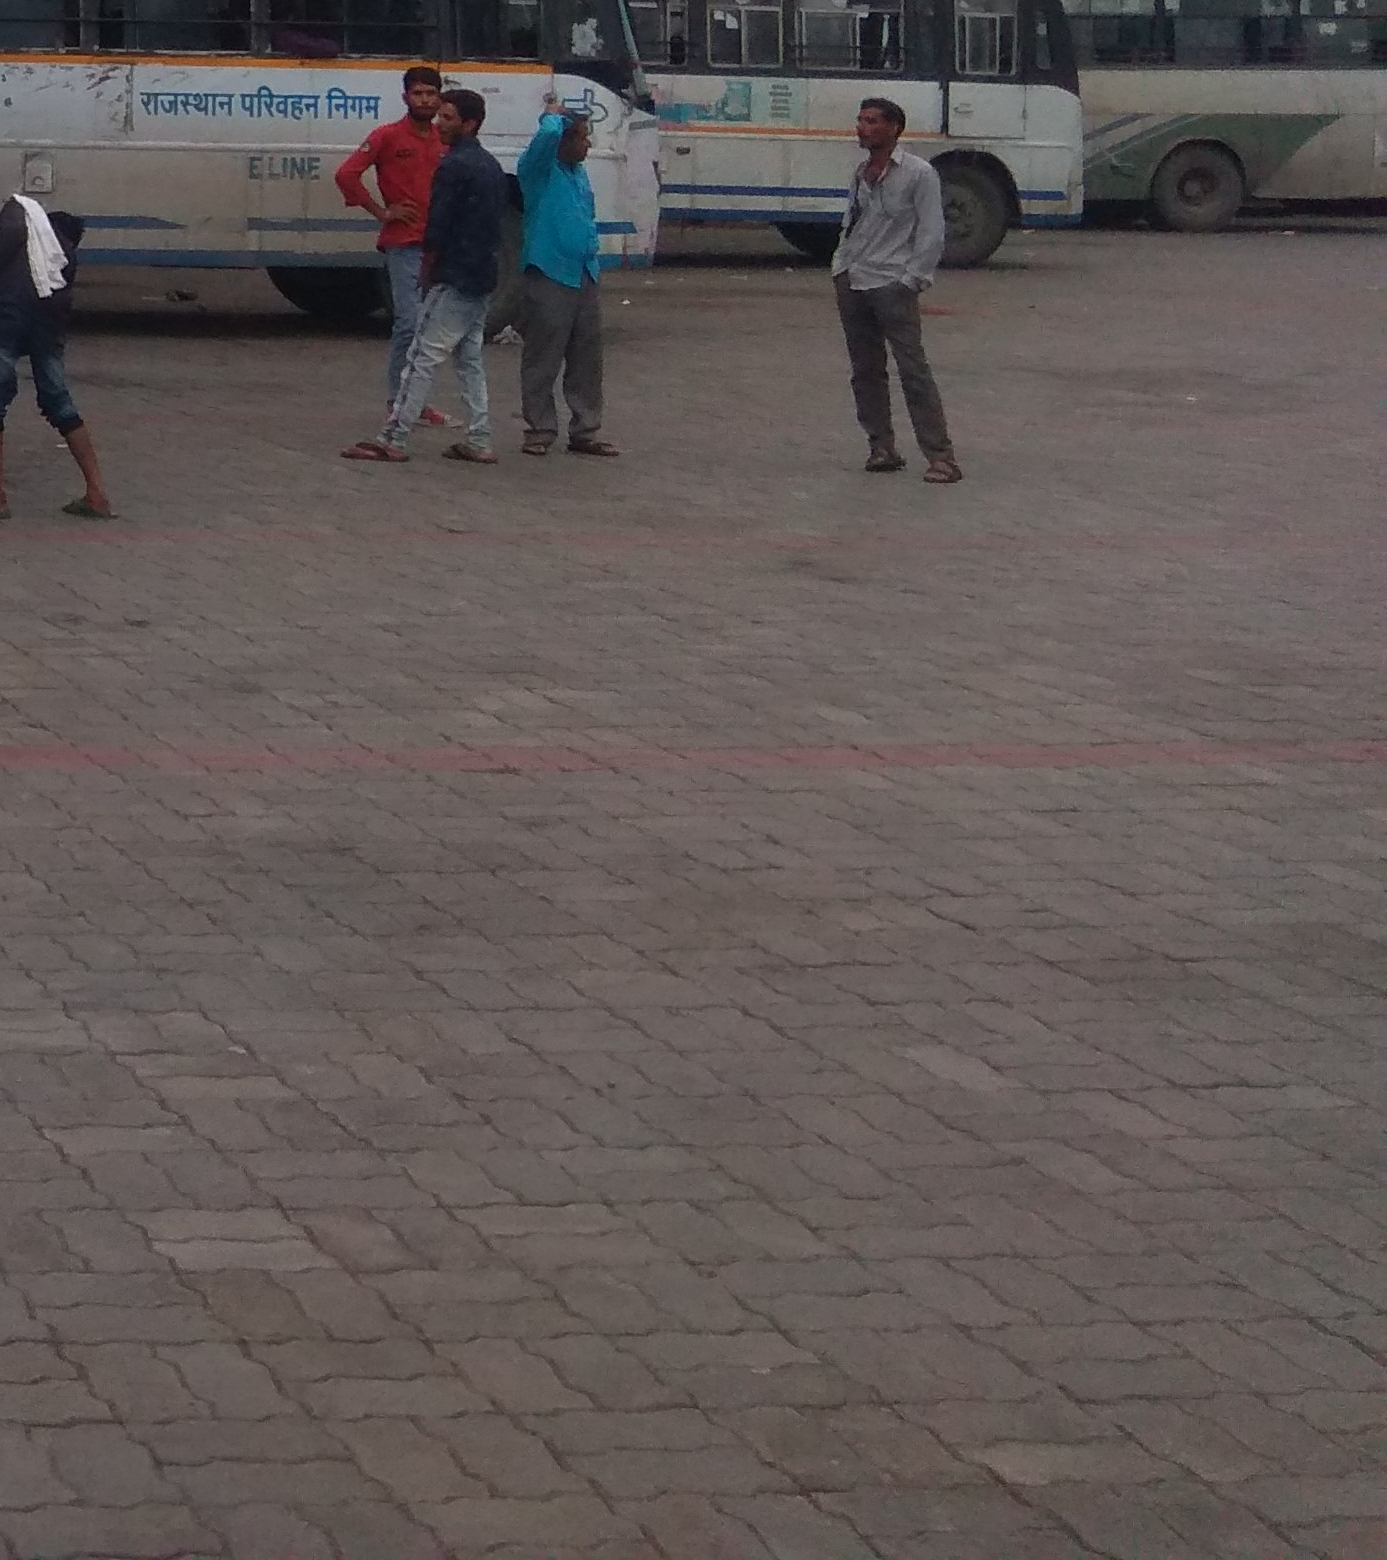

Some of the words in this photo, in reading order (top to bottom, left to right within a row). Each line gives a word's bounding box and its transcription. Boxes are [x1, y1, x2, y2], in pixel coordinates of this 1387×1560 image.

[140, 91, 235, 117] राजस्थान
[240, 85, 320, 121] परिवहन
[325, 87, 381, 120] निगम
